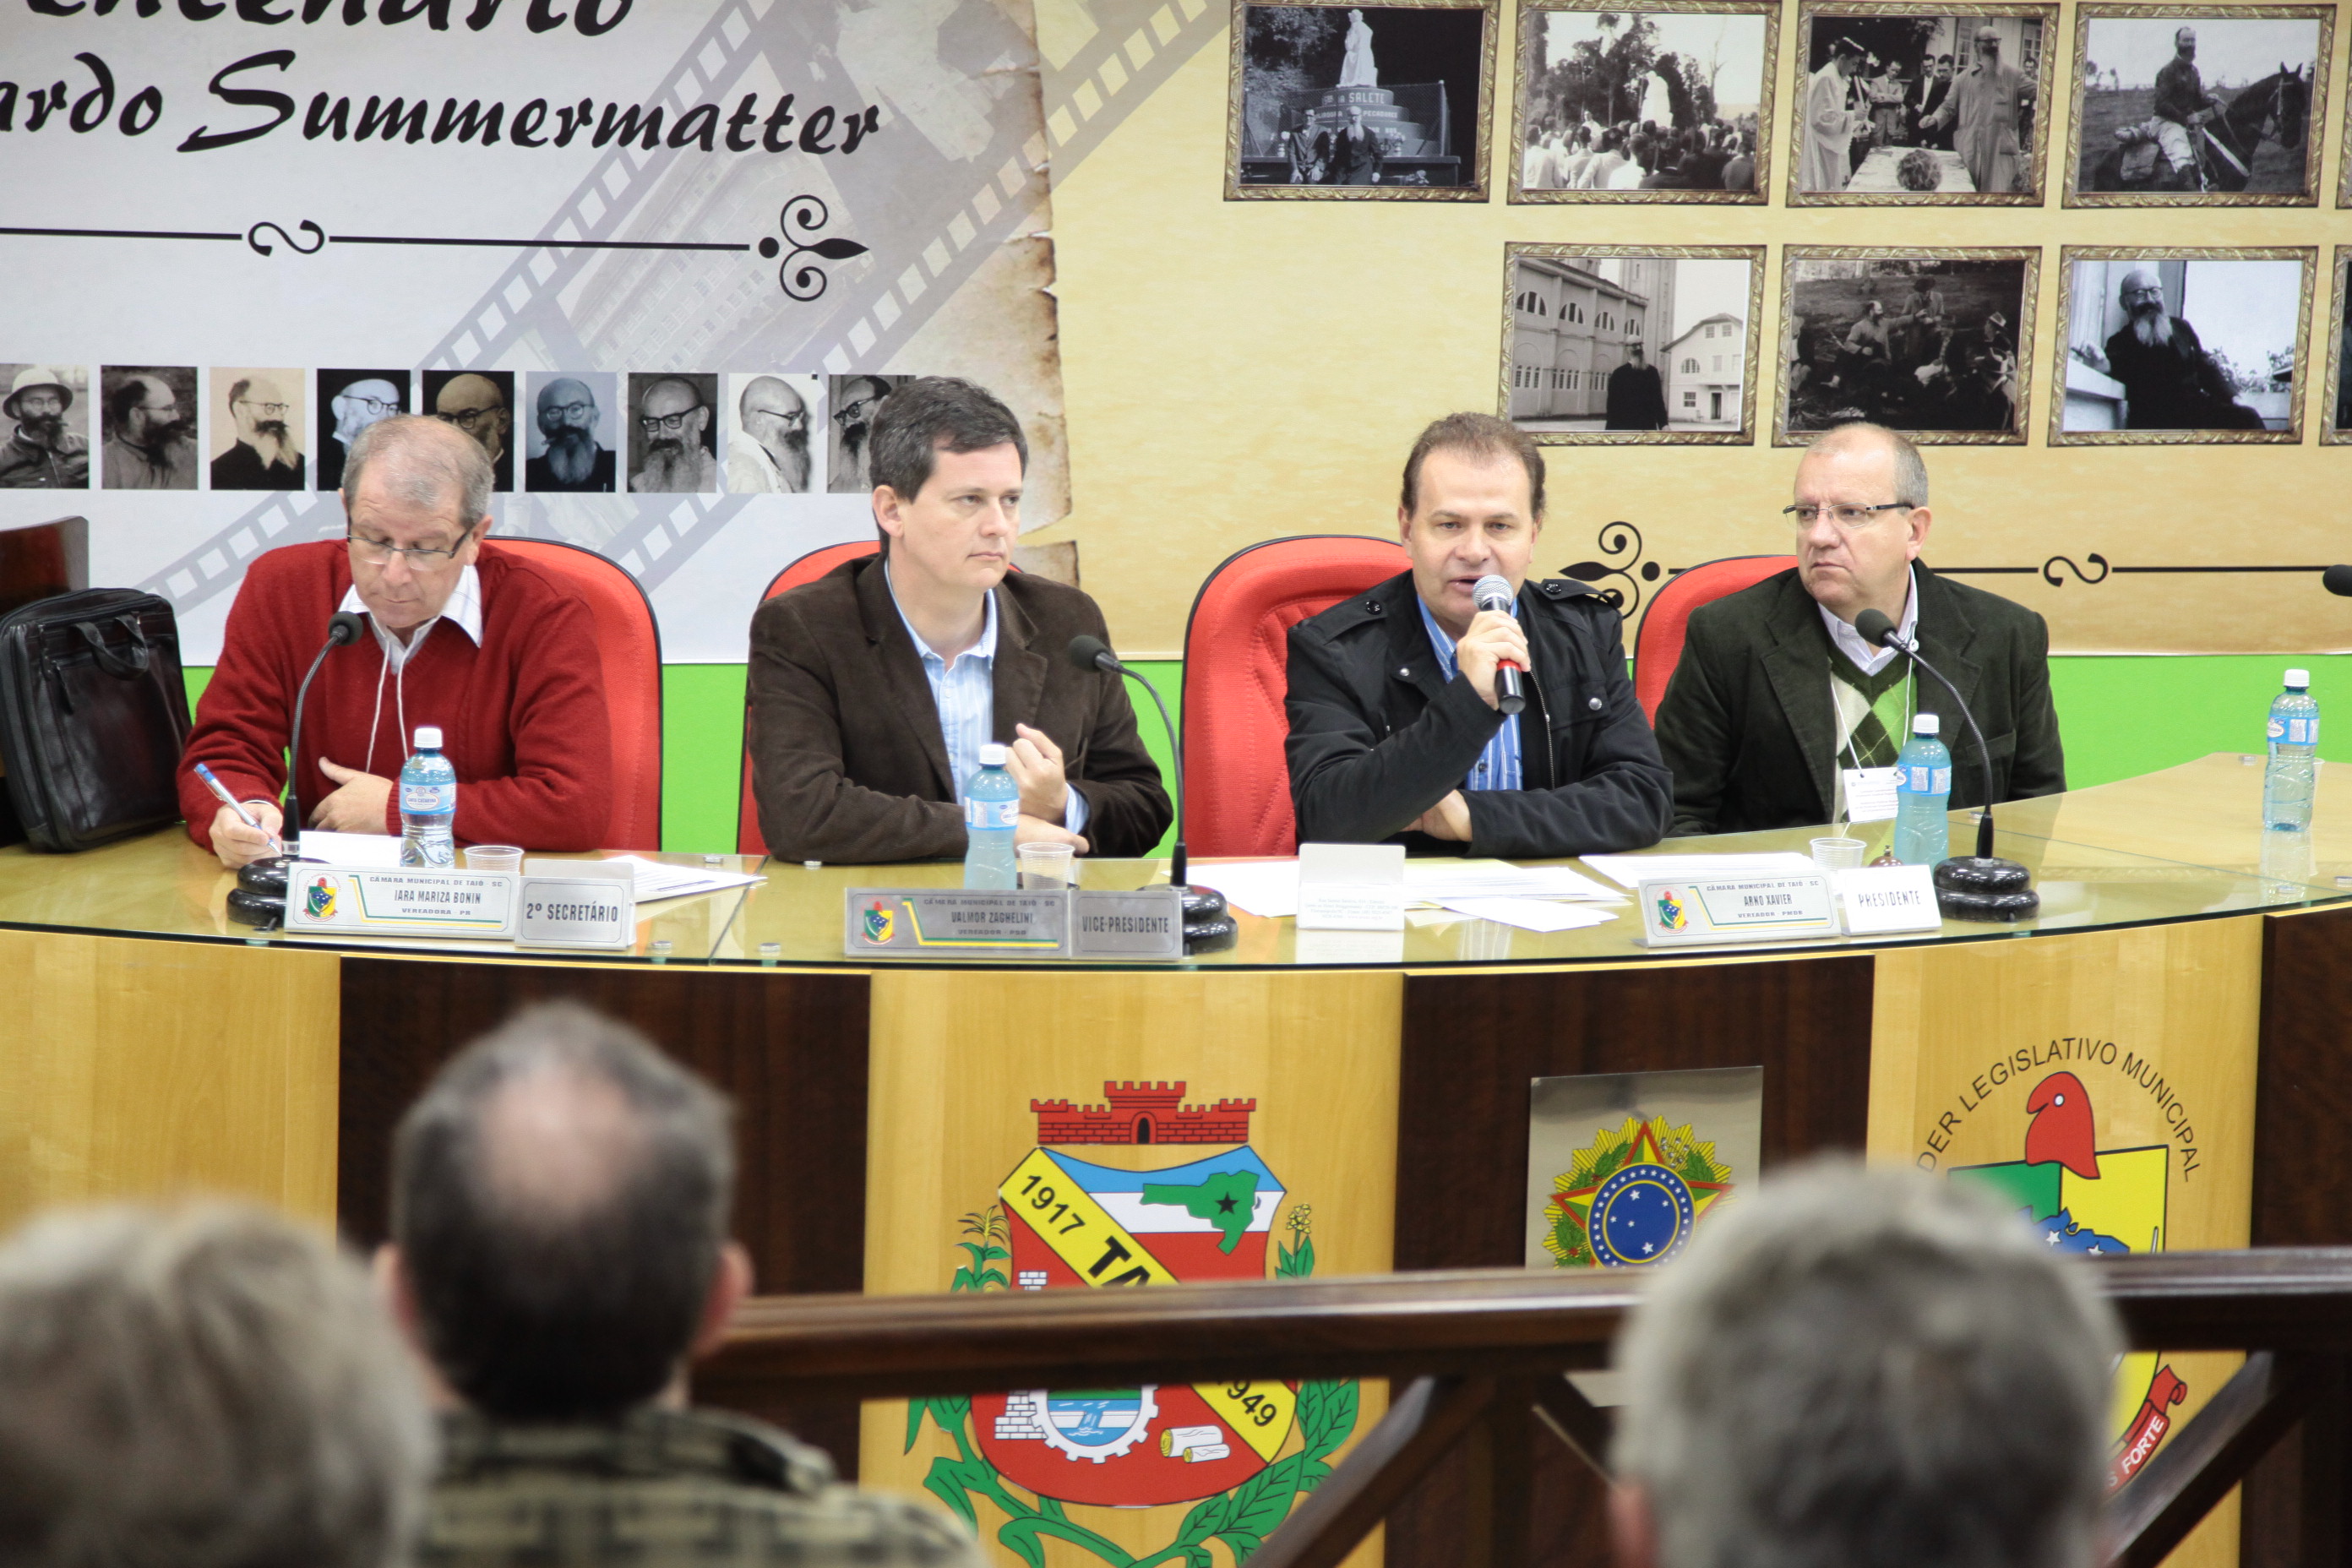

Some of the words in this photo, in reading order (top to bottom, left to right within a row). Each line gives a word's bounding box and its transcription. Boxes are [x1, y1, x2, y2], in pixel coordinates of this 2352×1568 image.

[176, 49, 880, 155] Summermatter
[394, 890, 415, 902] IARA
[417, 890, 450, 903] MARIZA
[453, 891, 482, 904] BONIN
[1744, 896, 1765, 906] ARNO
[1766, 894, 1793, 906] XAVIER
[1858, 890, 1921, 907] PRESIDENTE
[547, 901, 618, 923] SECRETÁRIO
[950, 912, 986, 923] VALMOR
[988, 912, 1033, 924] ZAGHELINI
[1081, 916, 1169, 934] VICE-PRESIDENTE
[1958, 1037, 2118, 1113] LEGISLATIVO
[2121, 1051, 2201, 1183] MUNICIPAL
[1021, 1174, 1086, 1236] 1917
[1226, 1380, 1277, 1427] 949
[2121, 1414, 2164, 1475] FORTE
